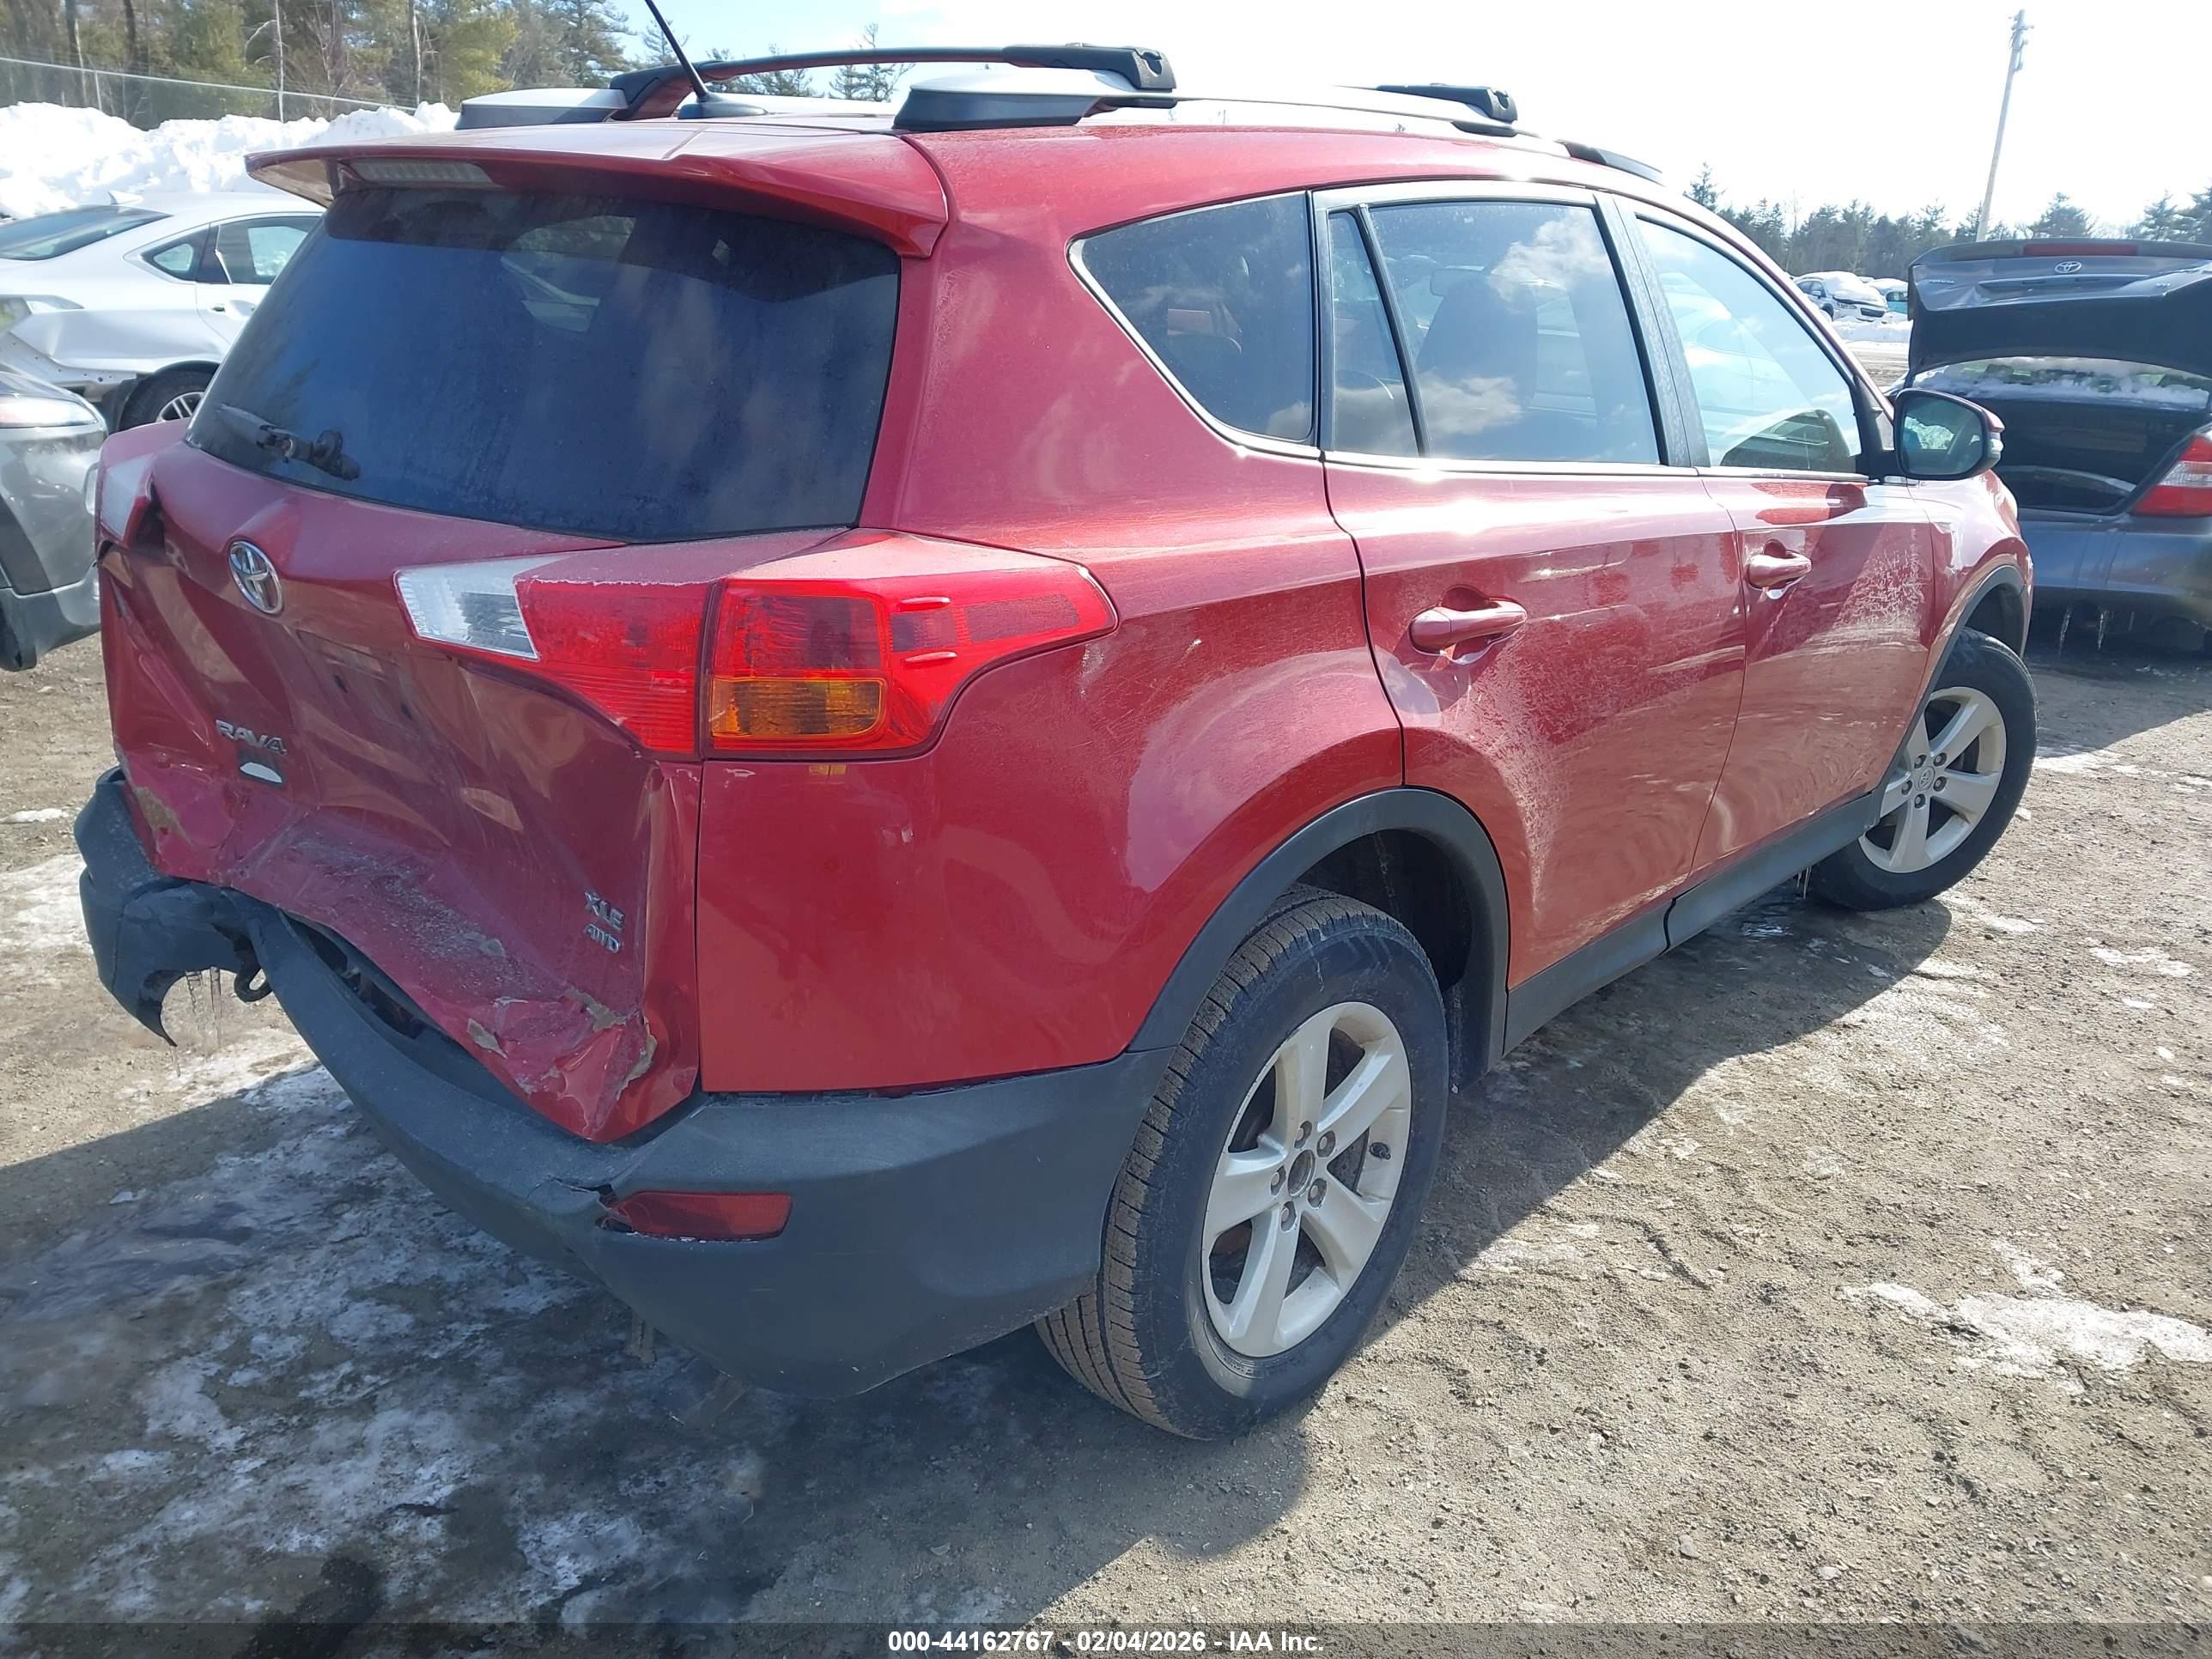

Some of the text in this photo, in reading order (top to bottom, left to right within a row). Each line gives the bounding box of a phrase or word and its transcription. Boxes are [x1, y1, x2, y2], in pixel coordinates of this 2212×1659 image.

[215, 719, 289, 756] RAV4
[584, 891, 625, 931] XLE
[582, 922, 620, 953] AWD
